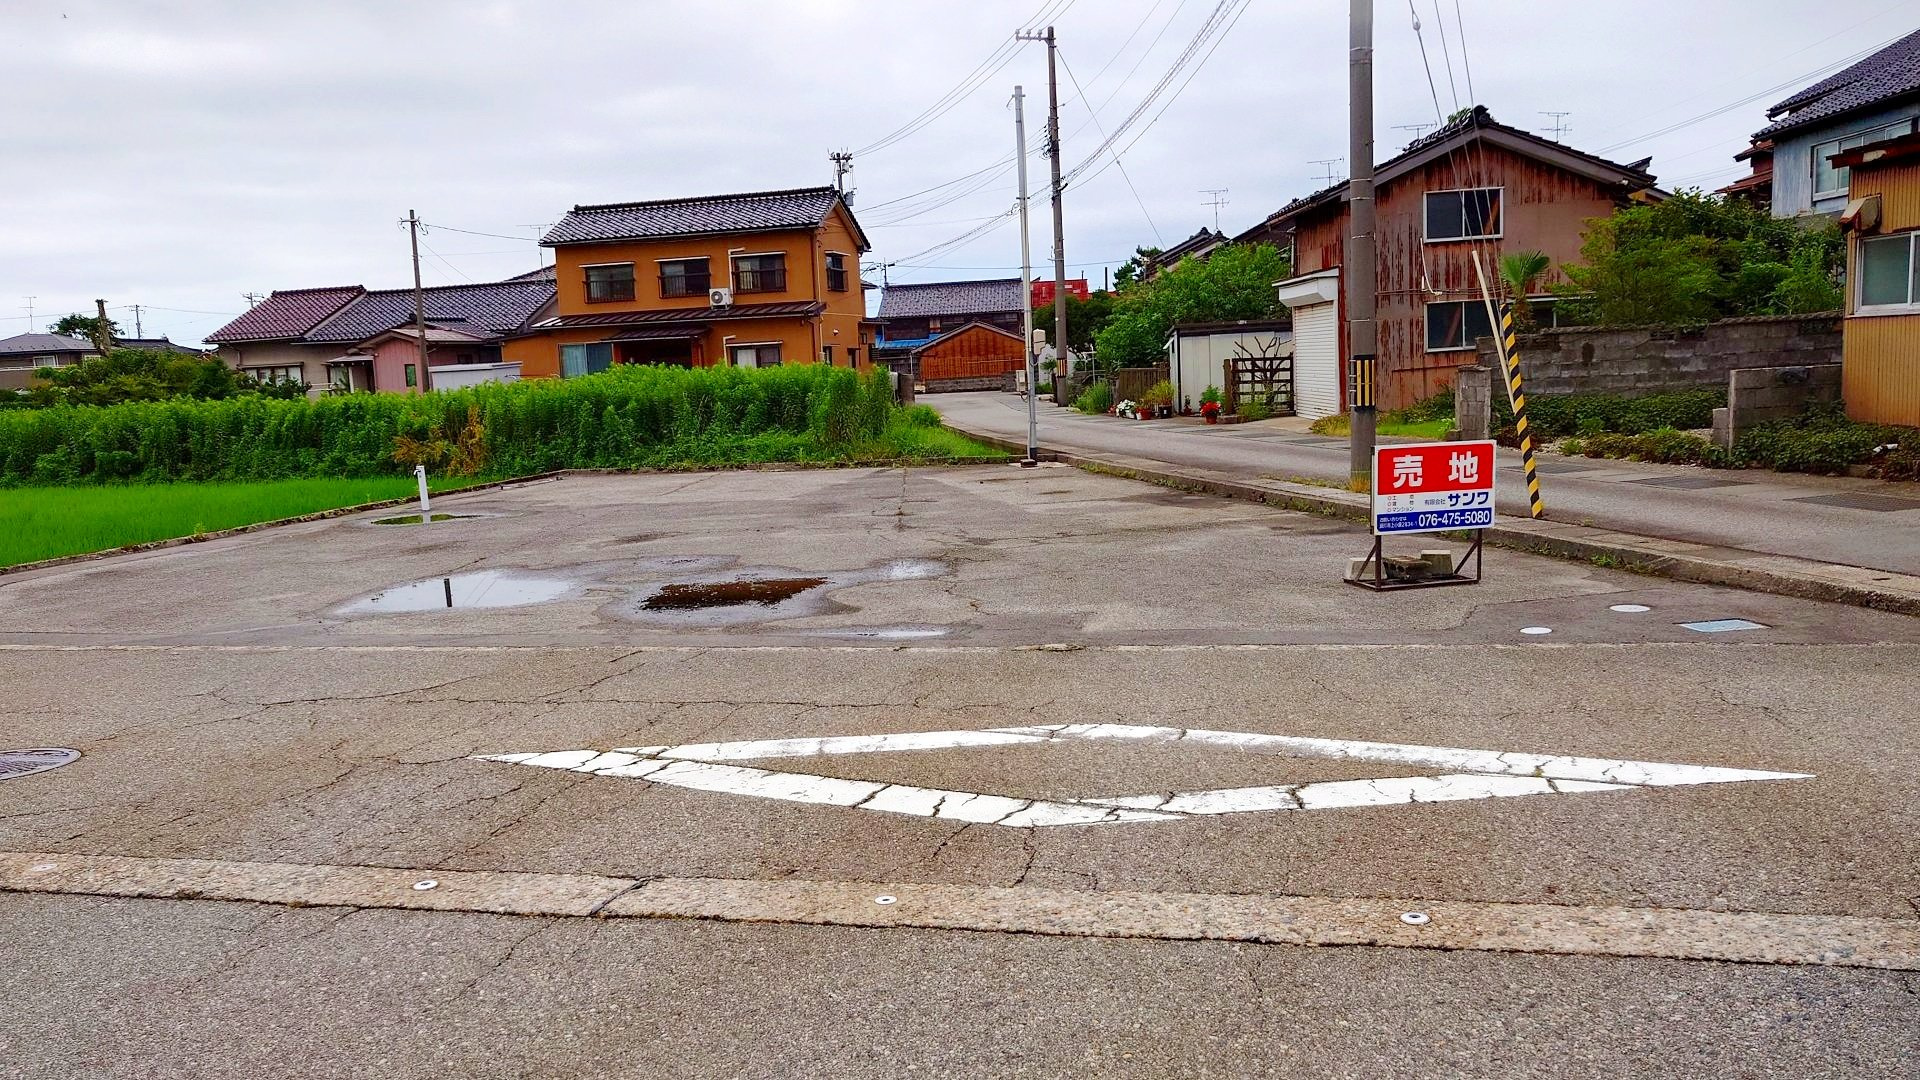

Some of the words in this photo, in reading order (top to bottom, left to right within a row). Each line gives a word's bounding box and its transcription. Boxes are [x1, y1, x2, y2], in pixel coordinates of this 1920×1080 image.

[1392, 450, 1479, 489] 売地
[1448, 491, 1489, 507] サンワ
[1418, 510, 1490, 527] 076-475-5080
